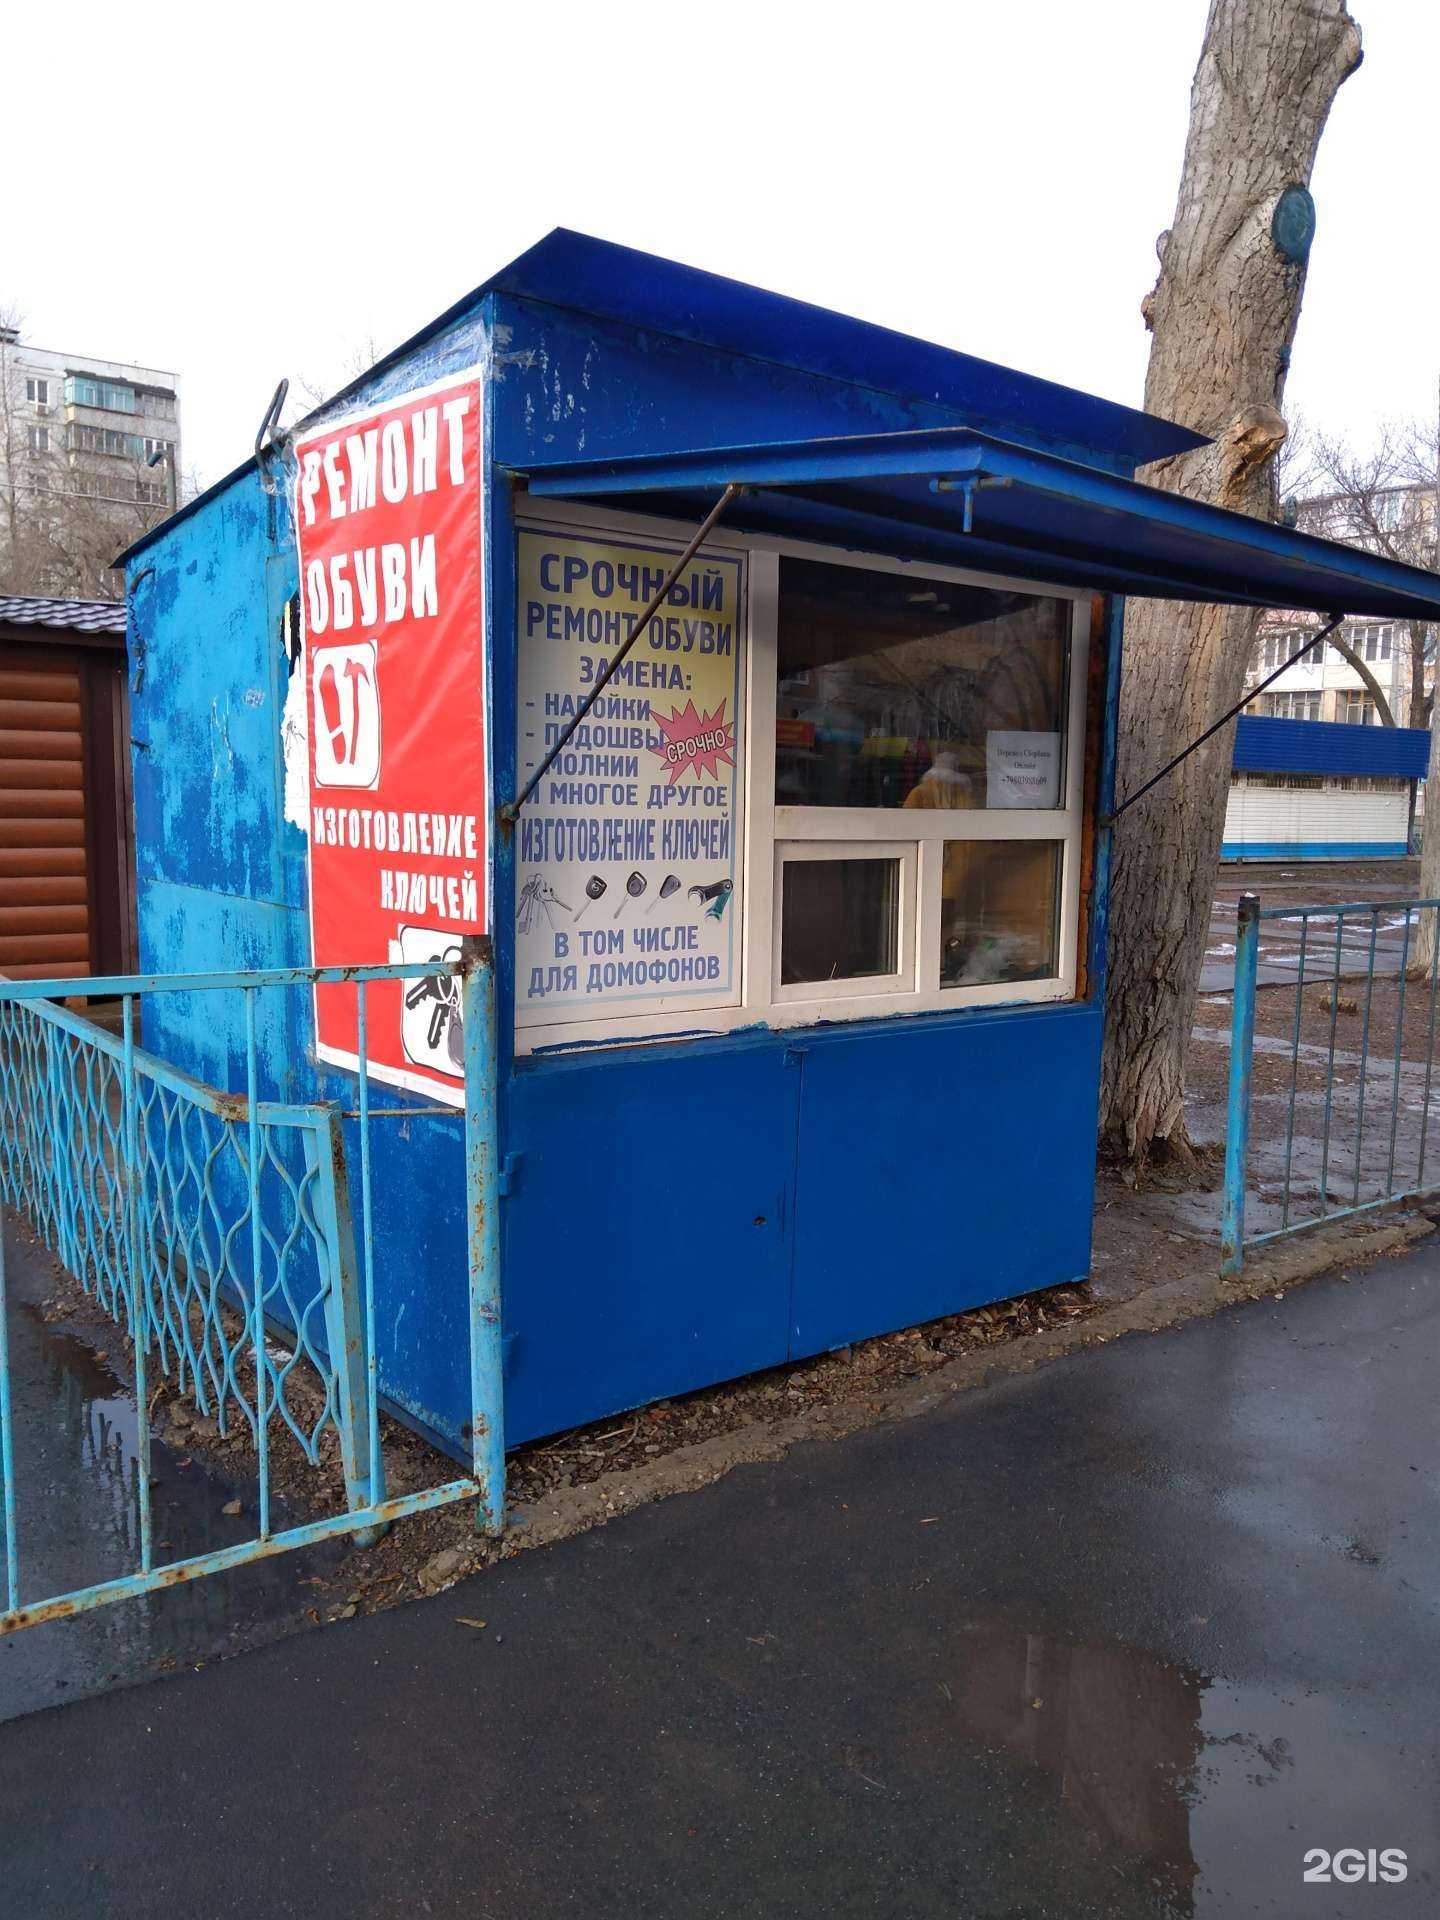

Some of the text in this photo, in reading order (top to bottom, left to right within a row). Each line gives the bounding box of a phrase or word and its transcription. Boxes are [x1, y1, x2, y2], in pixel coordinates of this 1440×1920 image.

[302, 396, 470, 525] РЕМОНТ
[307, 534, 439, 634] ОБУВИ
[540, 553, 723, 612] СРОЧНЫЙ
[527, 601, 731, 656] РЕМОНТ ОБУВИ
[579, 656, 692, 690] ЗАМЕНА:
[666, 728, 726, 764] СРОЧНО
[550, 783, 638, 805] МНОГОЕ
[647, 784, 727, 809] ДРУГОЕ
[313, 807, 477, 859] ИЗГОТОВЛЕНИЕ
[521, 813, 730, 862] ИЗГОТОВЛЕНИЕ КЛЮЧЕЙ
[380, 870, 478, 922] КЛЮЧЕЙ
[554, 925, 699, 958] В ТОМ ЧИСЛЕ
[528, 956, 720, 998] ДЛЯ ДОМОФОНОВ
